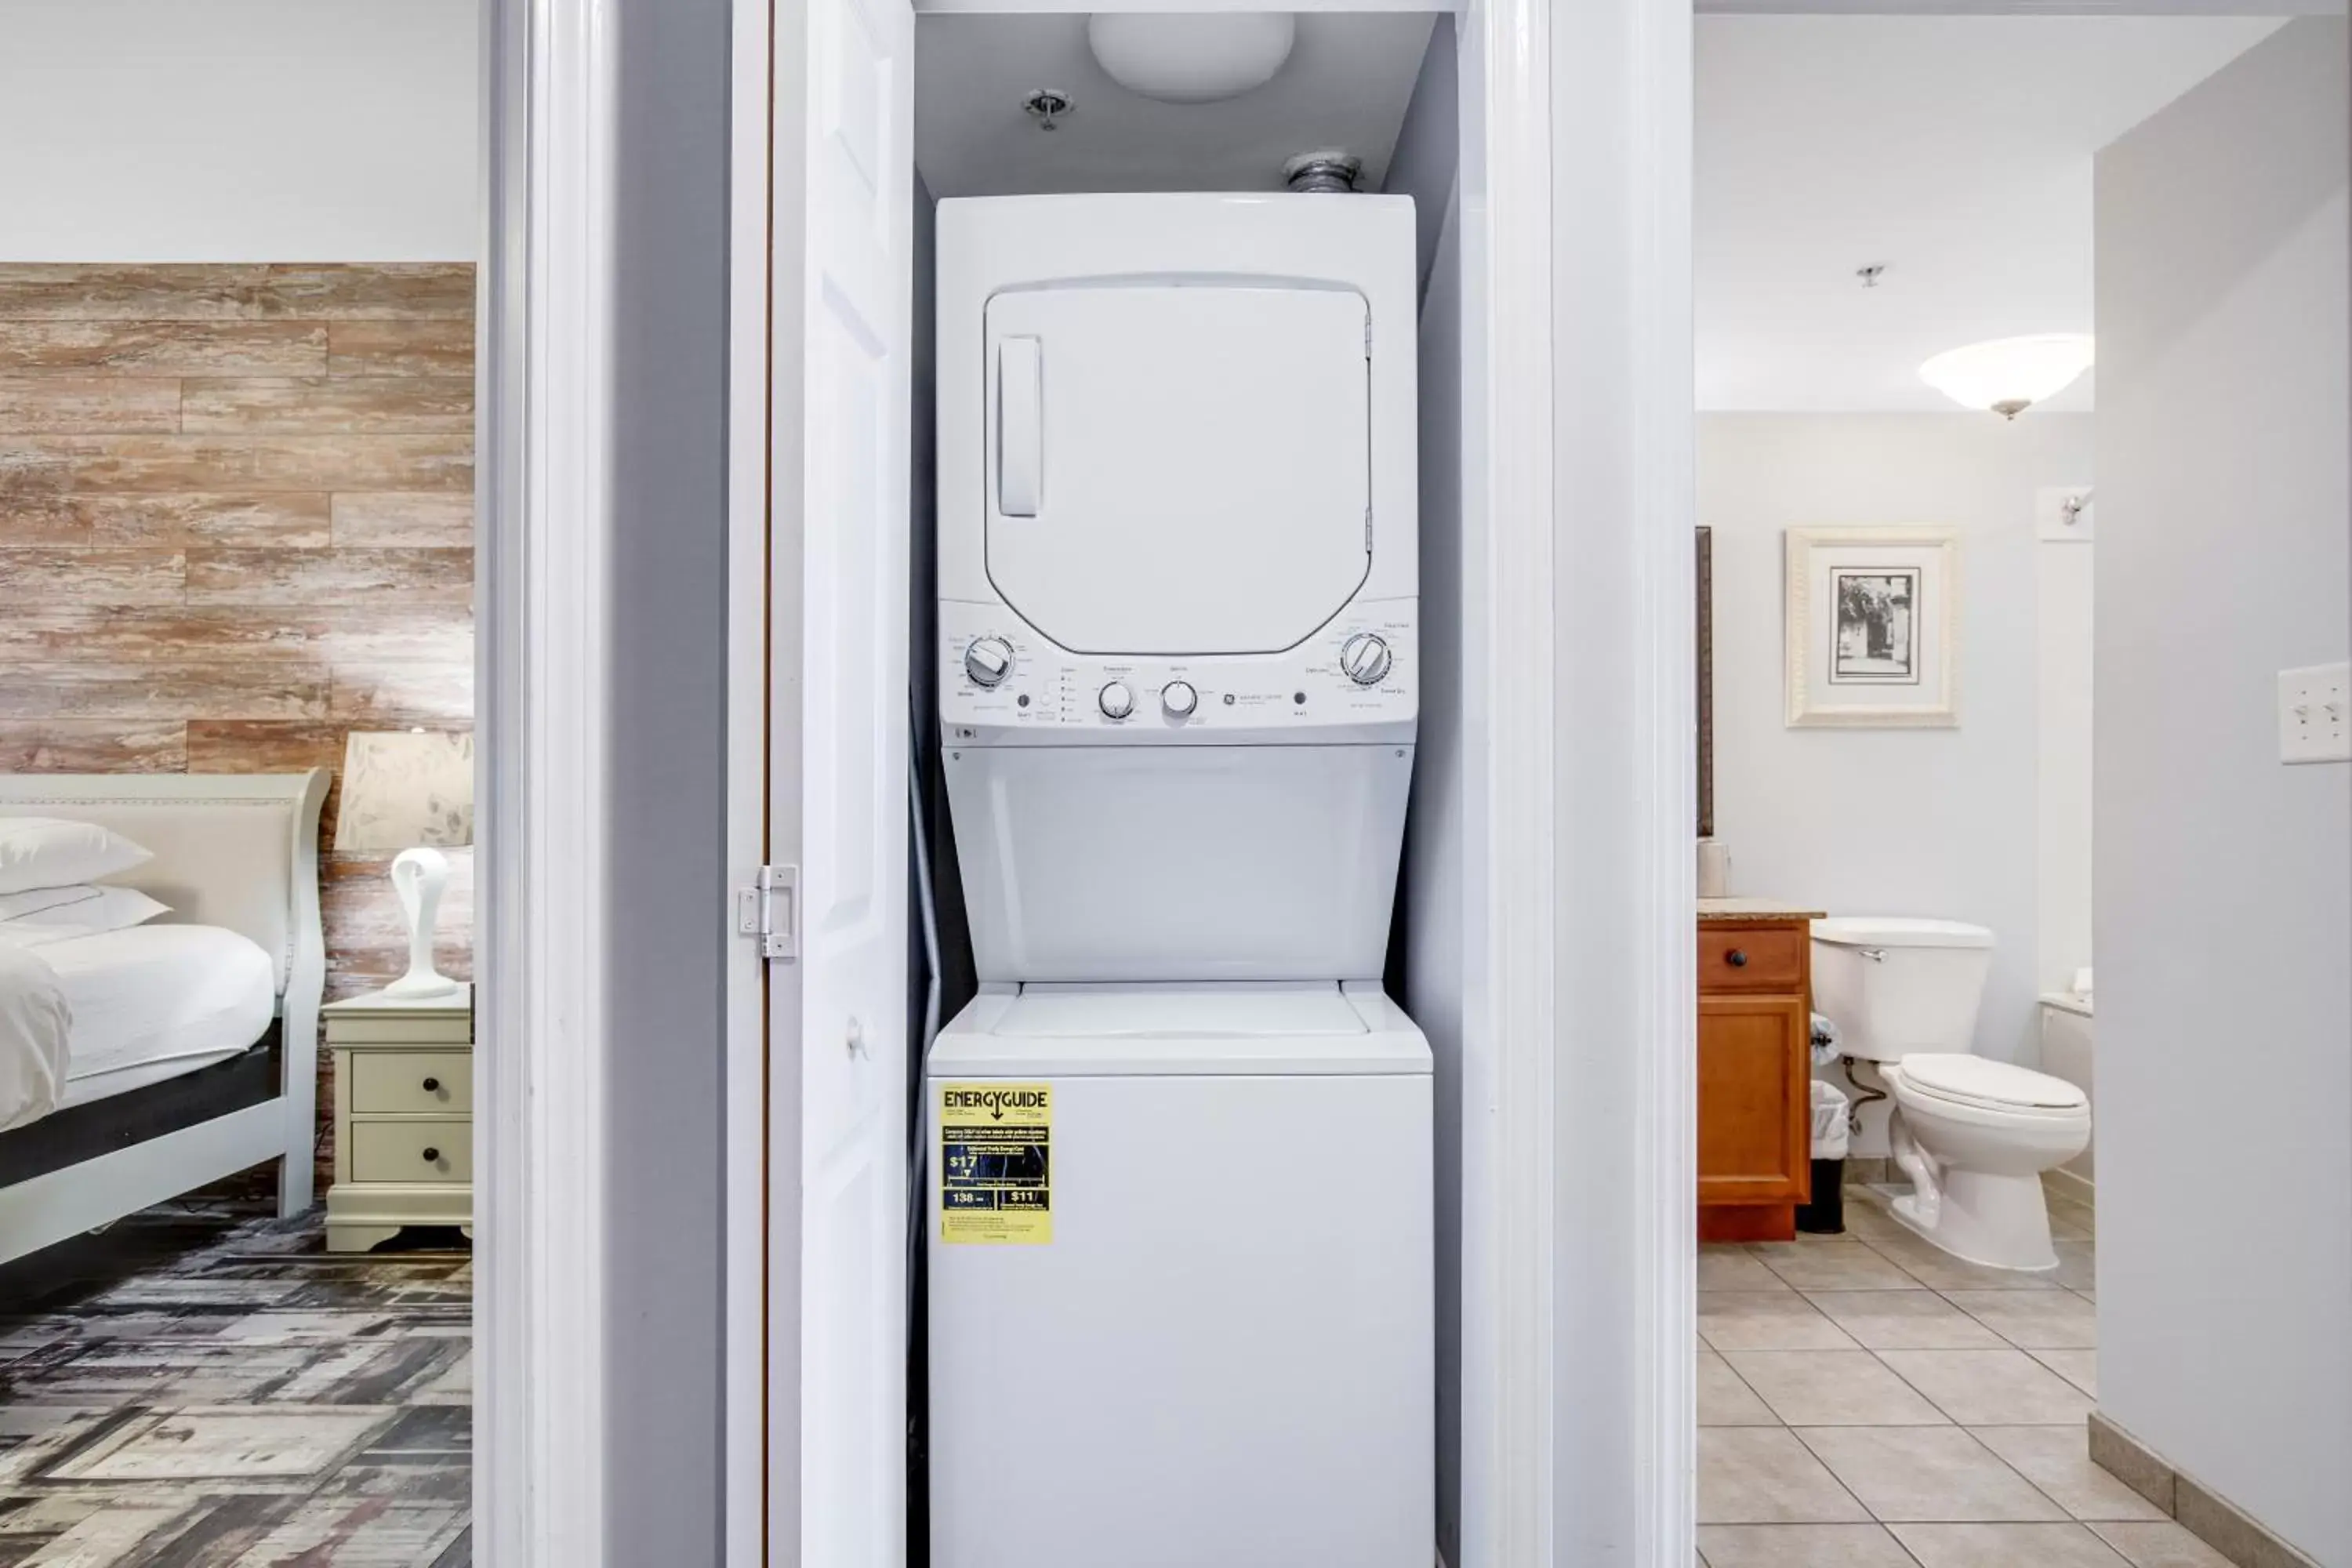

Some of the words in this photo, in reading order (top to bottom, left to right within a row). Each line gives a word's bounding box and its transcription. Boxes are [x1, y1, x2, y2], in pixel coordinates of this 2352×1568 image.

[945, 1091, 1047, 1108] ENERGYGUIDE
[949, 1156, 978, 1167] $17
[1011, 1191, 1033, 1202] $11
